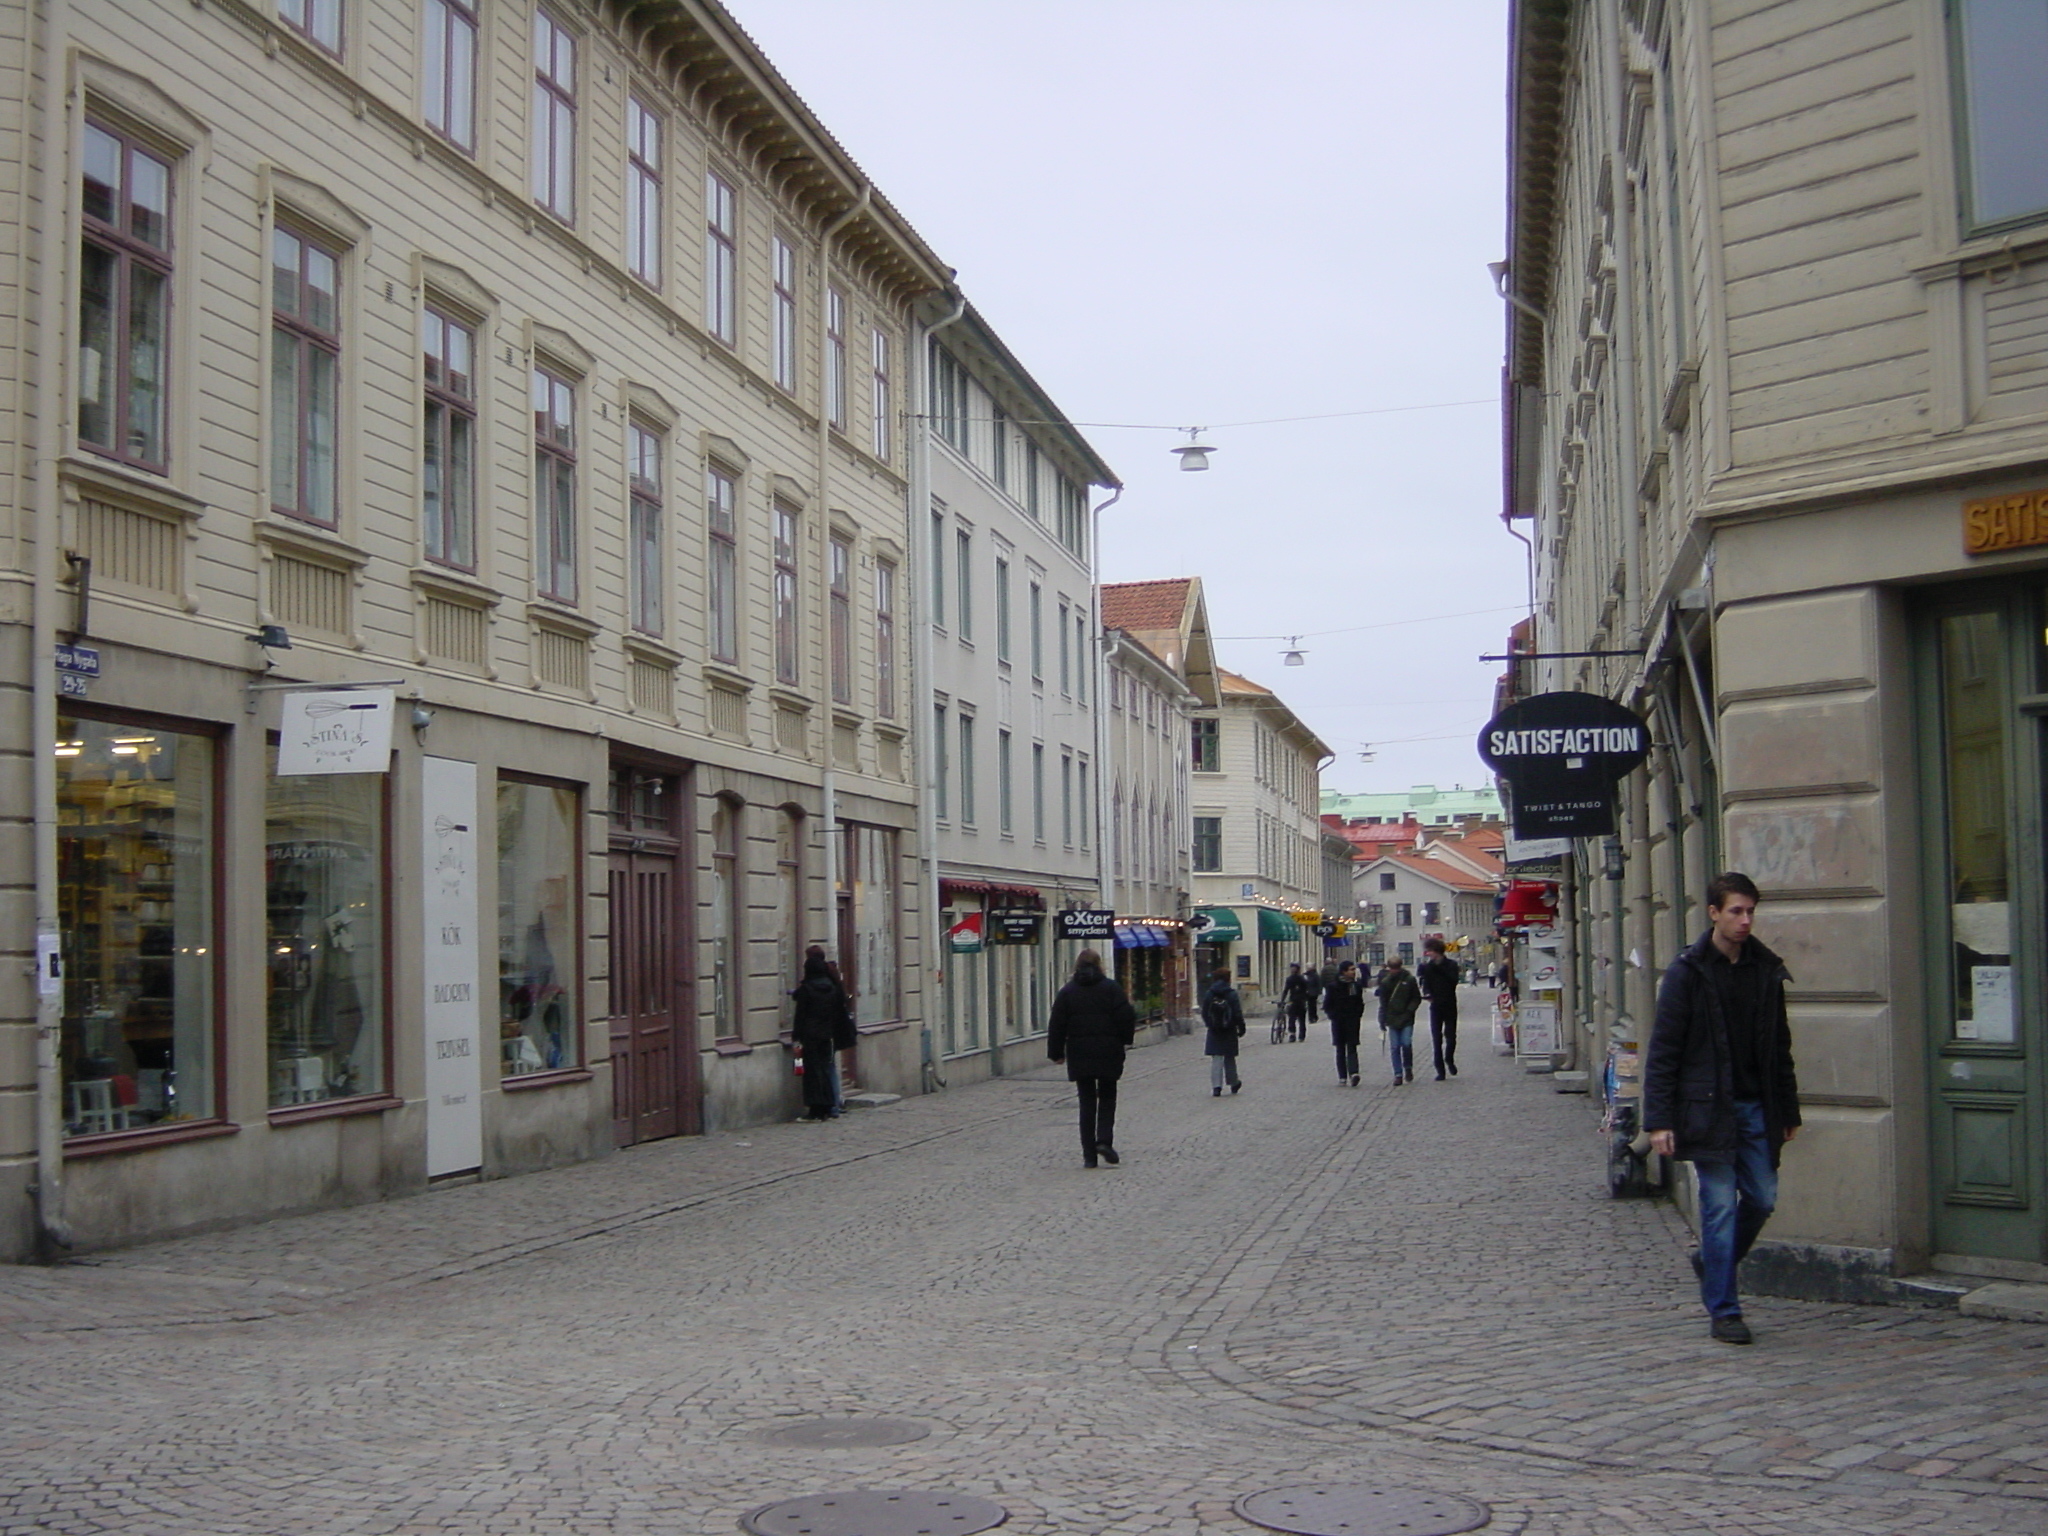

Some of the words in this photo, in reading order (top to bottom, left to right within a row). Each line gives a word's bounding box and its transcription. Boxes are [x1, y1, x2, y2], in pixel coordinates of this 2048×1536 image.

[1490, 727, 1638, 756] SATISFACTION
[1523, 804, 1555, 812] TWIST
[1557, 803, 1564, 811] &
[1565, 801, 1602, 810] TANGO
[1064, 911, 1111, 926] eXter
